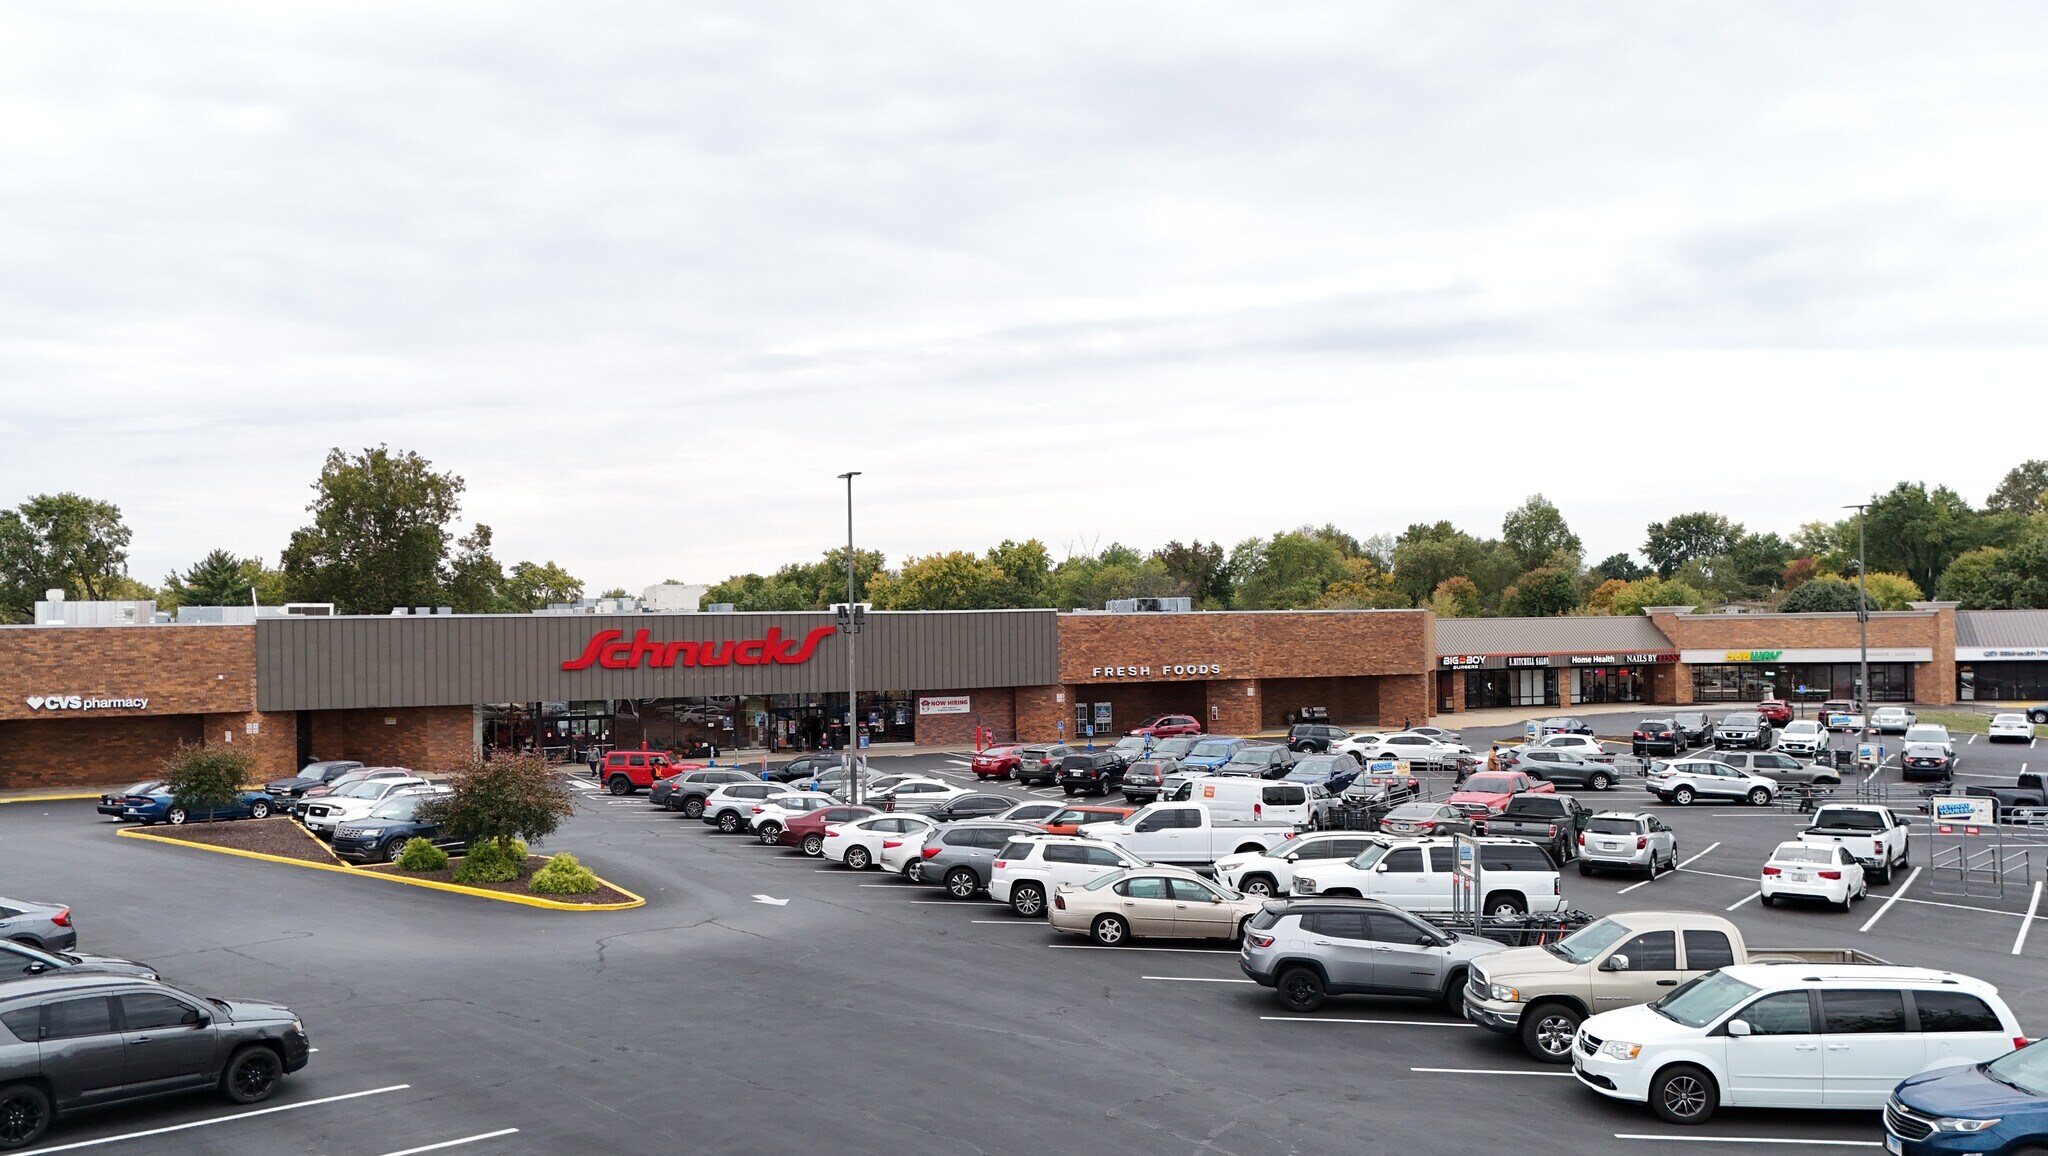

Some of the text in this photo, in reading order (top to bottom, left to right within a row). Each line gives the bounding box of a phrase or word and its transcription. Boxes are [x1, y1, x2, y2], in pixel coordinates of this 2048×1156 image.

[562, 627, 836, 671] Schnucks
[1443, 655, 1486, 666] BIG BOY
[1572, 655, 1615, 664] Home Health
[1626, 654, 1647, 663] NAILS
[1648, 654, 1657, 662] BY
[1725, 651, 1782, 661] SUBWAY
[1092, 664, 1220, 677] FRESH FOODS
[44, 696, 149, 711] CVS pharmacy
